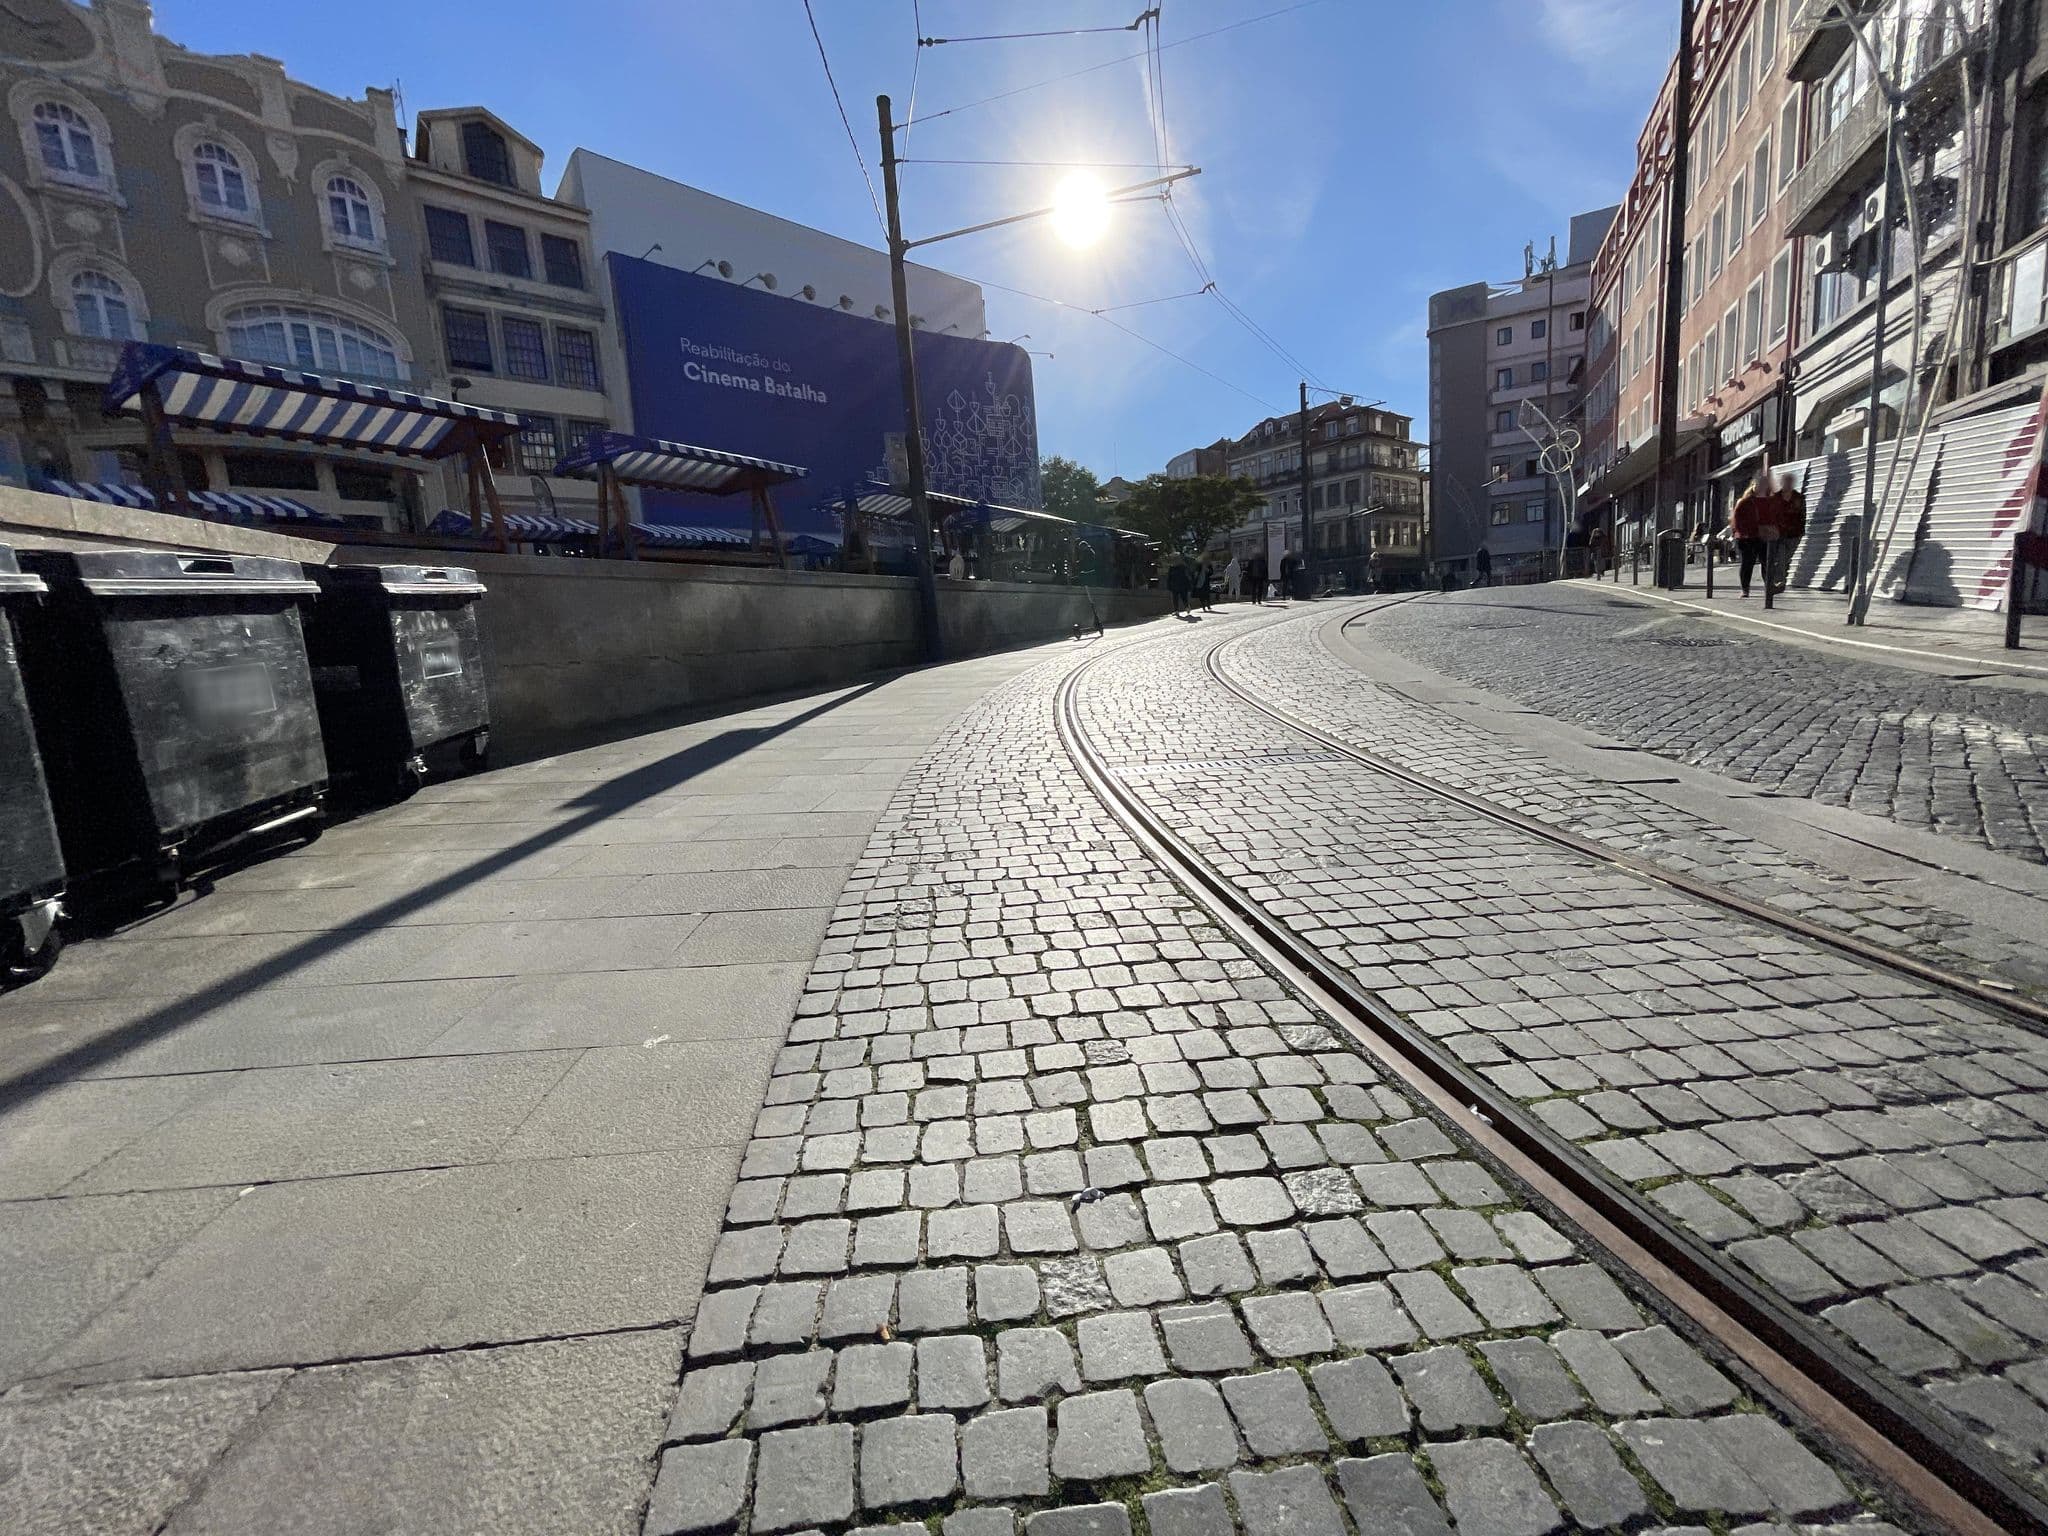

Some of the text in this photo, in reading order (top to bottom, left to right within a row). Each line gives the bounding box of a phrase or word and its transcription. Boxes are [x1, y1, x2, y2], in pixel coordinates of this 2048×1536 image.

[680, 337, 792, 373] Reabilitação do
[683, 361, 828, 403] Cinema Batalha
